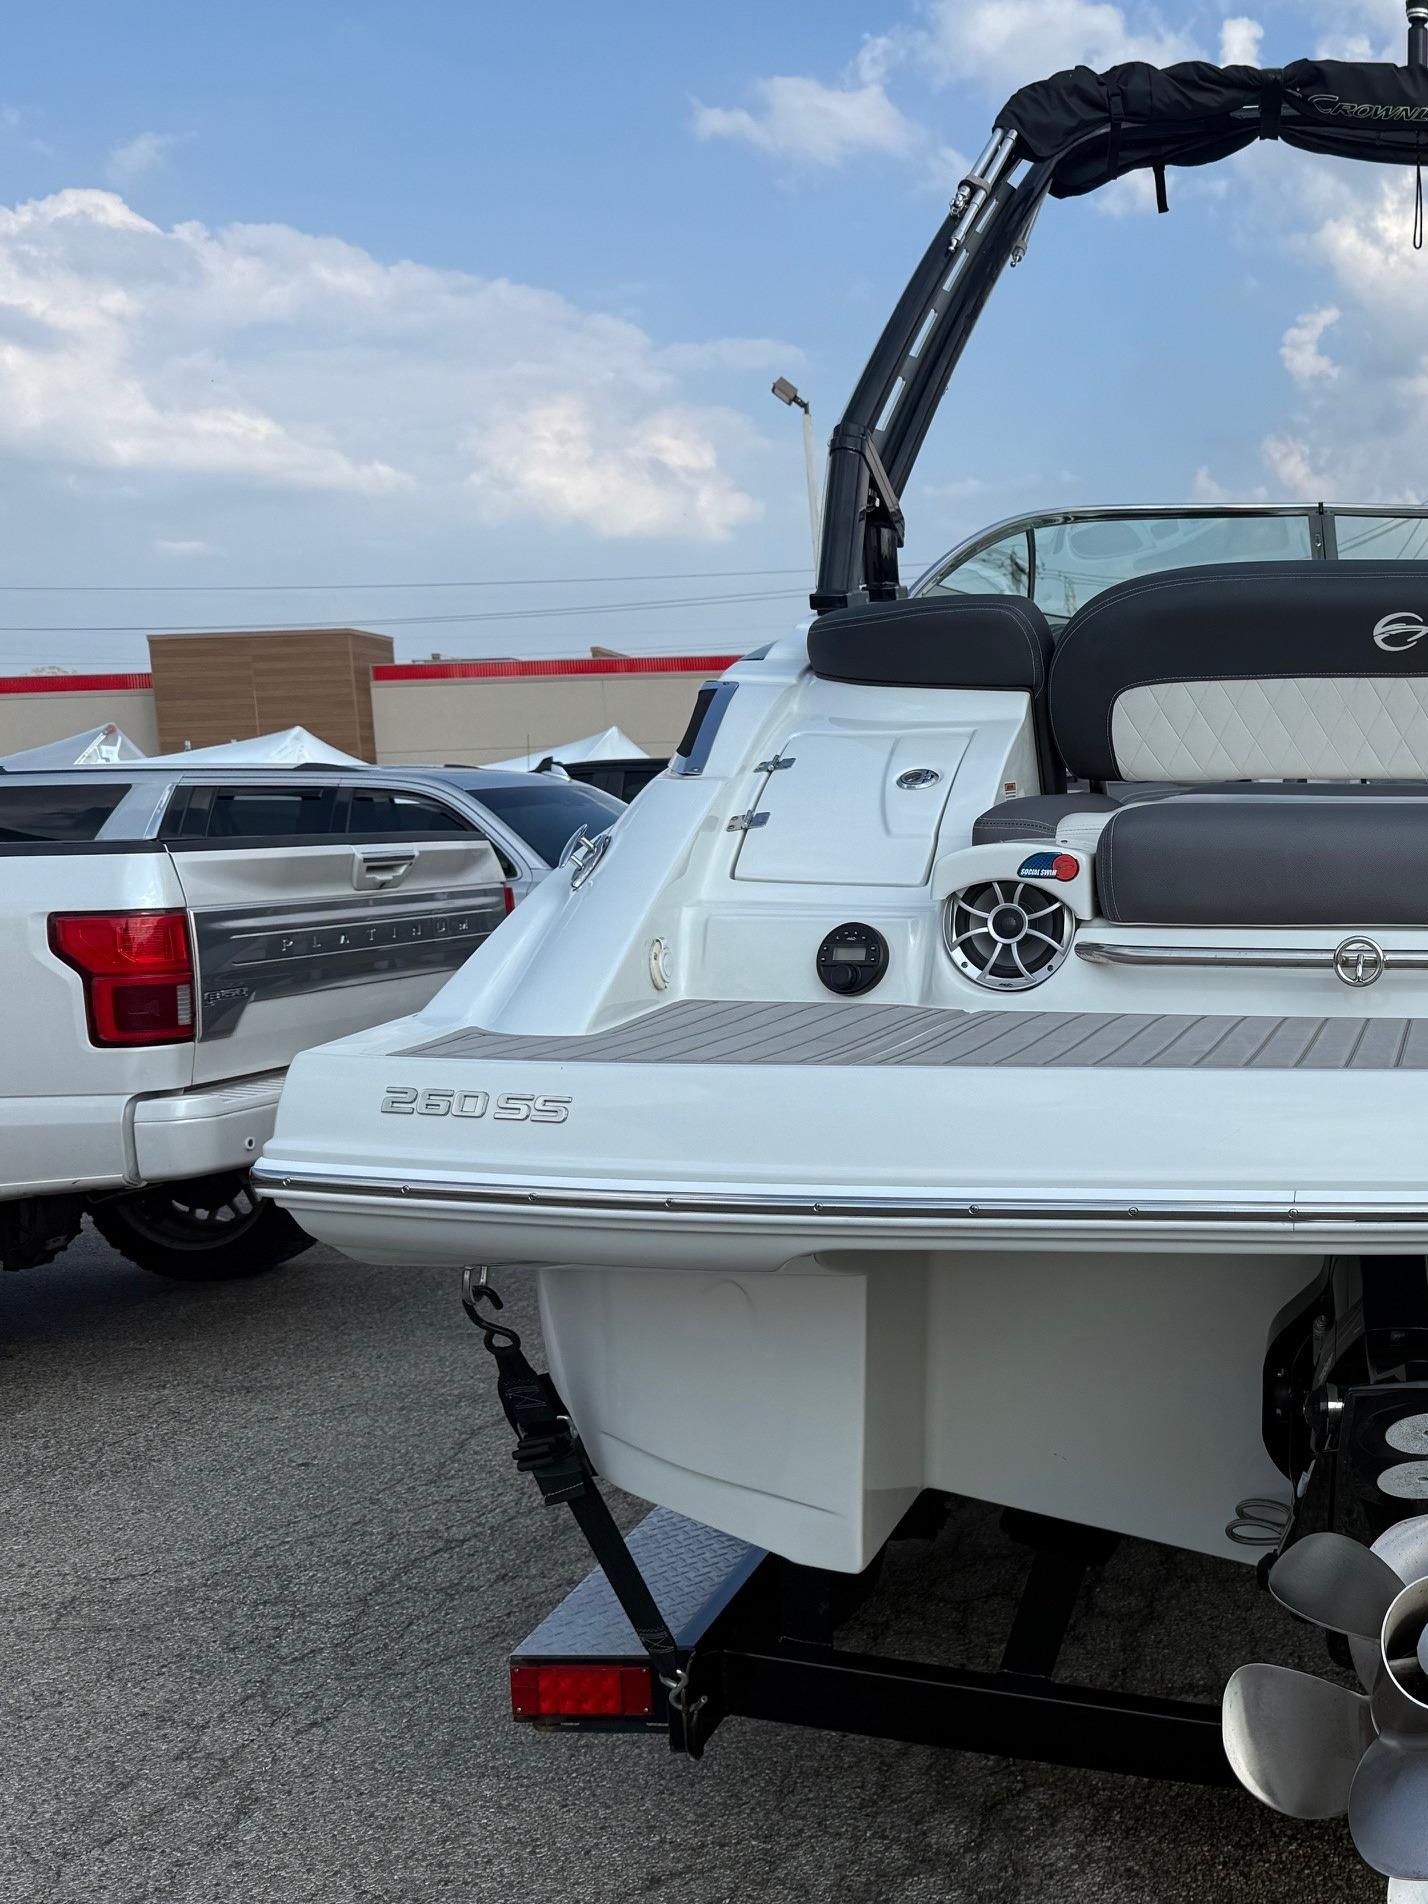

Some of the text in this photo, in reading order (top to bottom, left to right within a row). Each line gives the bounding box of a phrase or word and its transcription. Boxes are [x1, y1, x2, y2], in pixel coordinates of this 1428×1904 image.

[1020, 868, 1040, 876] SOCIAL
[282, 919, 470, 951] PLATINUM
[381, 1086, 573, 1124] 260 SS
